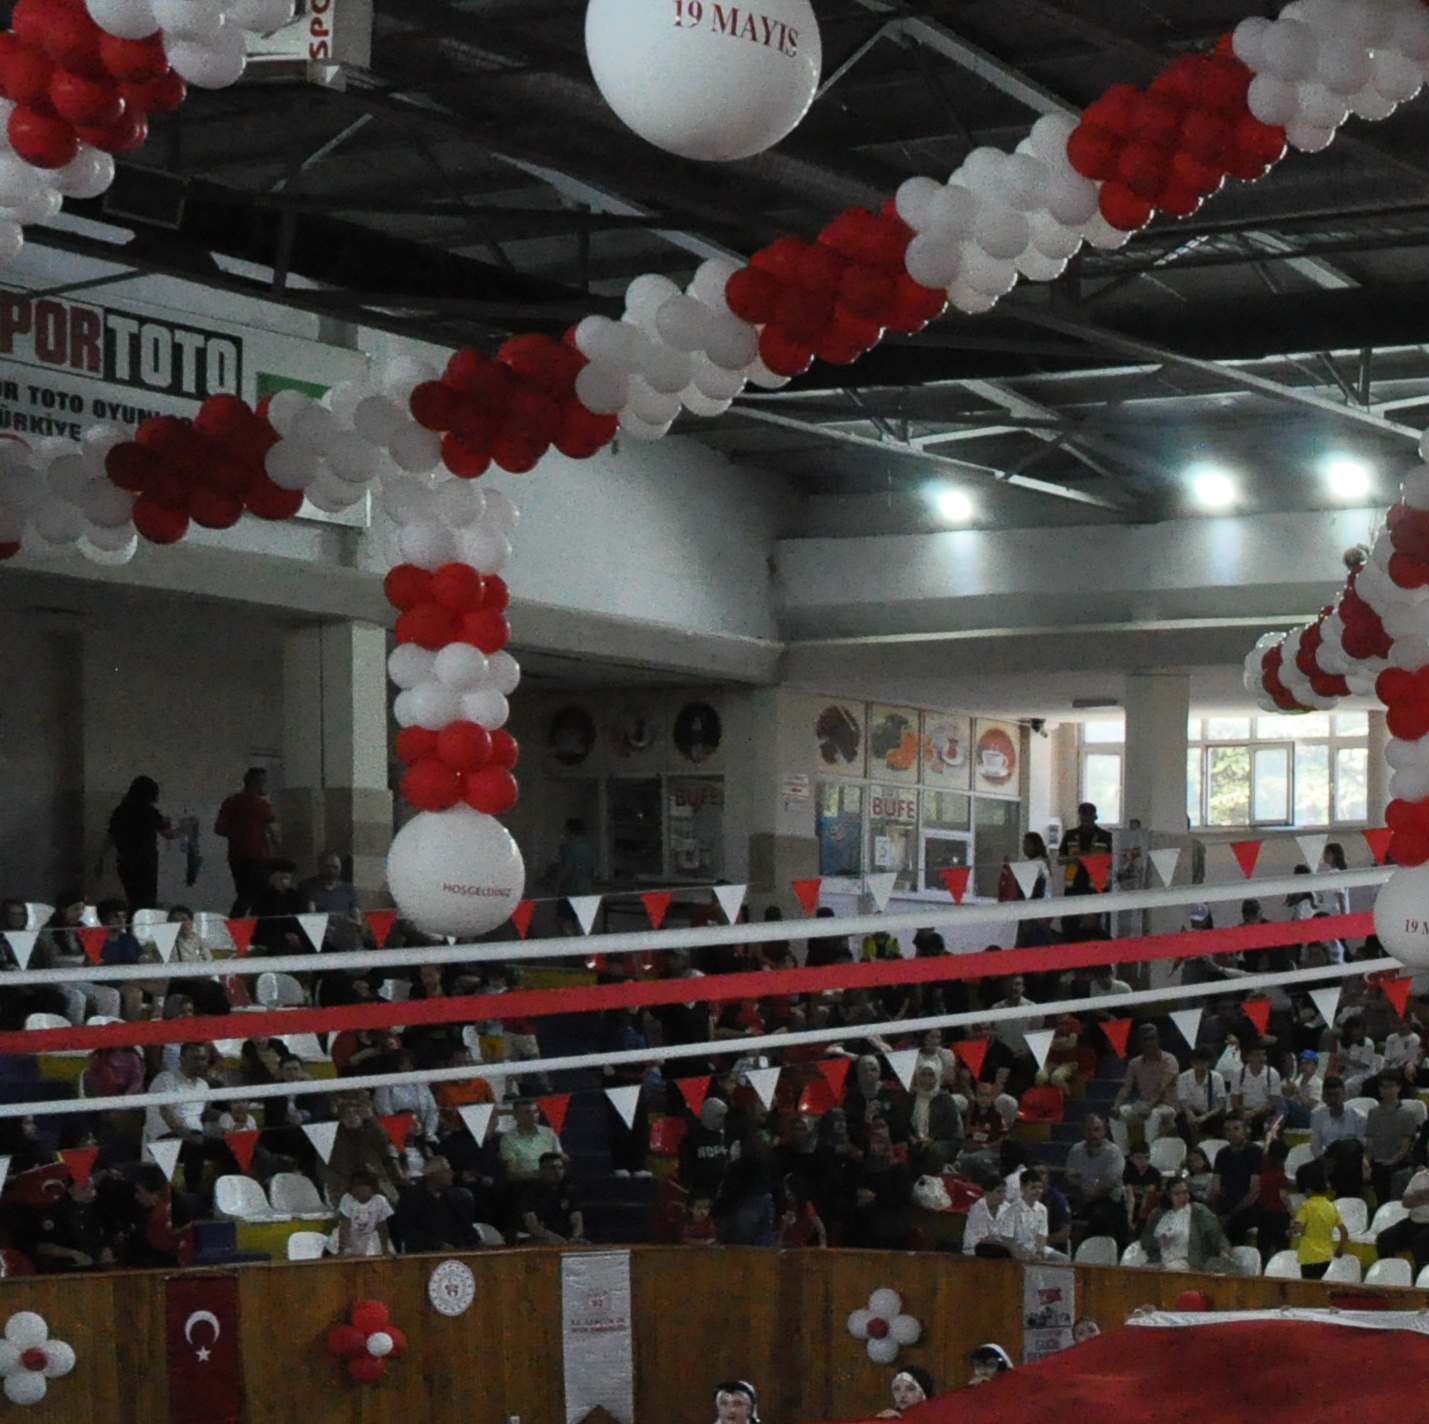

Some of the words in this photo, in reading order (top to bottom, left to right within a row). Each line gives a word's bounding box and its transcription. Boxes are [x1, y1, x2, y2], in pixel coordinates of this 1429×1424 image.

[711, 3, 799, 58] MAYIS
[27, 384, 85, 414] TOTO
[1405, 919, 1419, 934] 19
